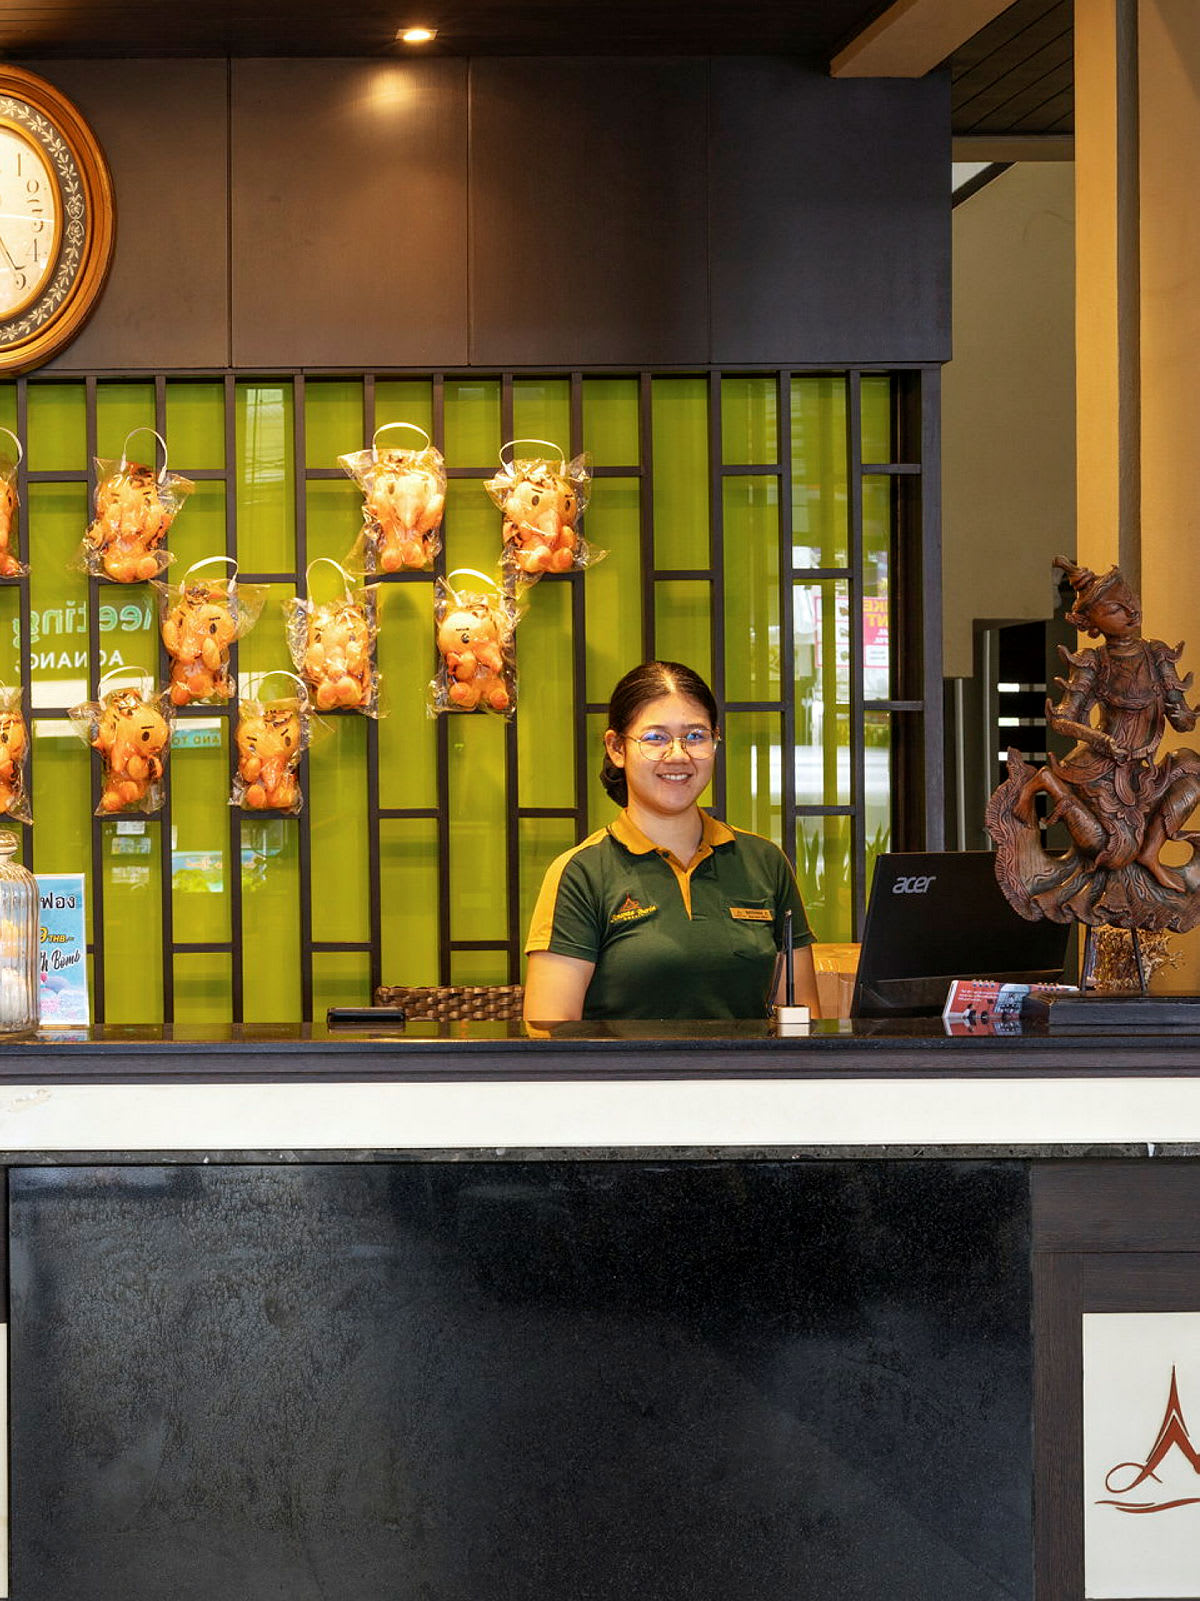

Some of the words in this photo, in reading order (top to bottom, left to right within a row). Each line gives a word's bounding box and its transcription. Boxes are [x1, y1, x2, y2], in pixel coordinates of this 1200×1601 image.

[16, 152, 22, 177] 1
[26, 179, 40, 204] 2
[31, 208, 44, 233] 3
[25, 238, 39, 263] 4
[14, 265, 27, 290] 5
[892, 875, 937, 894] acer
